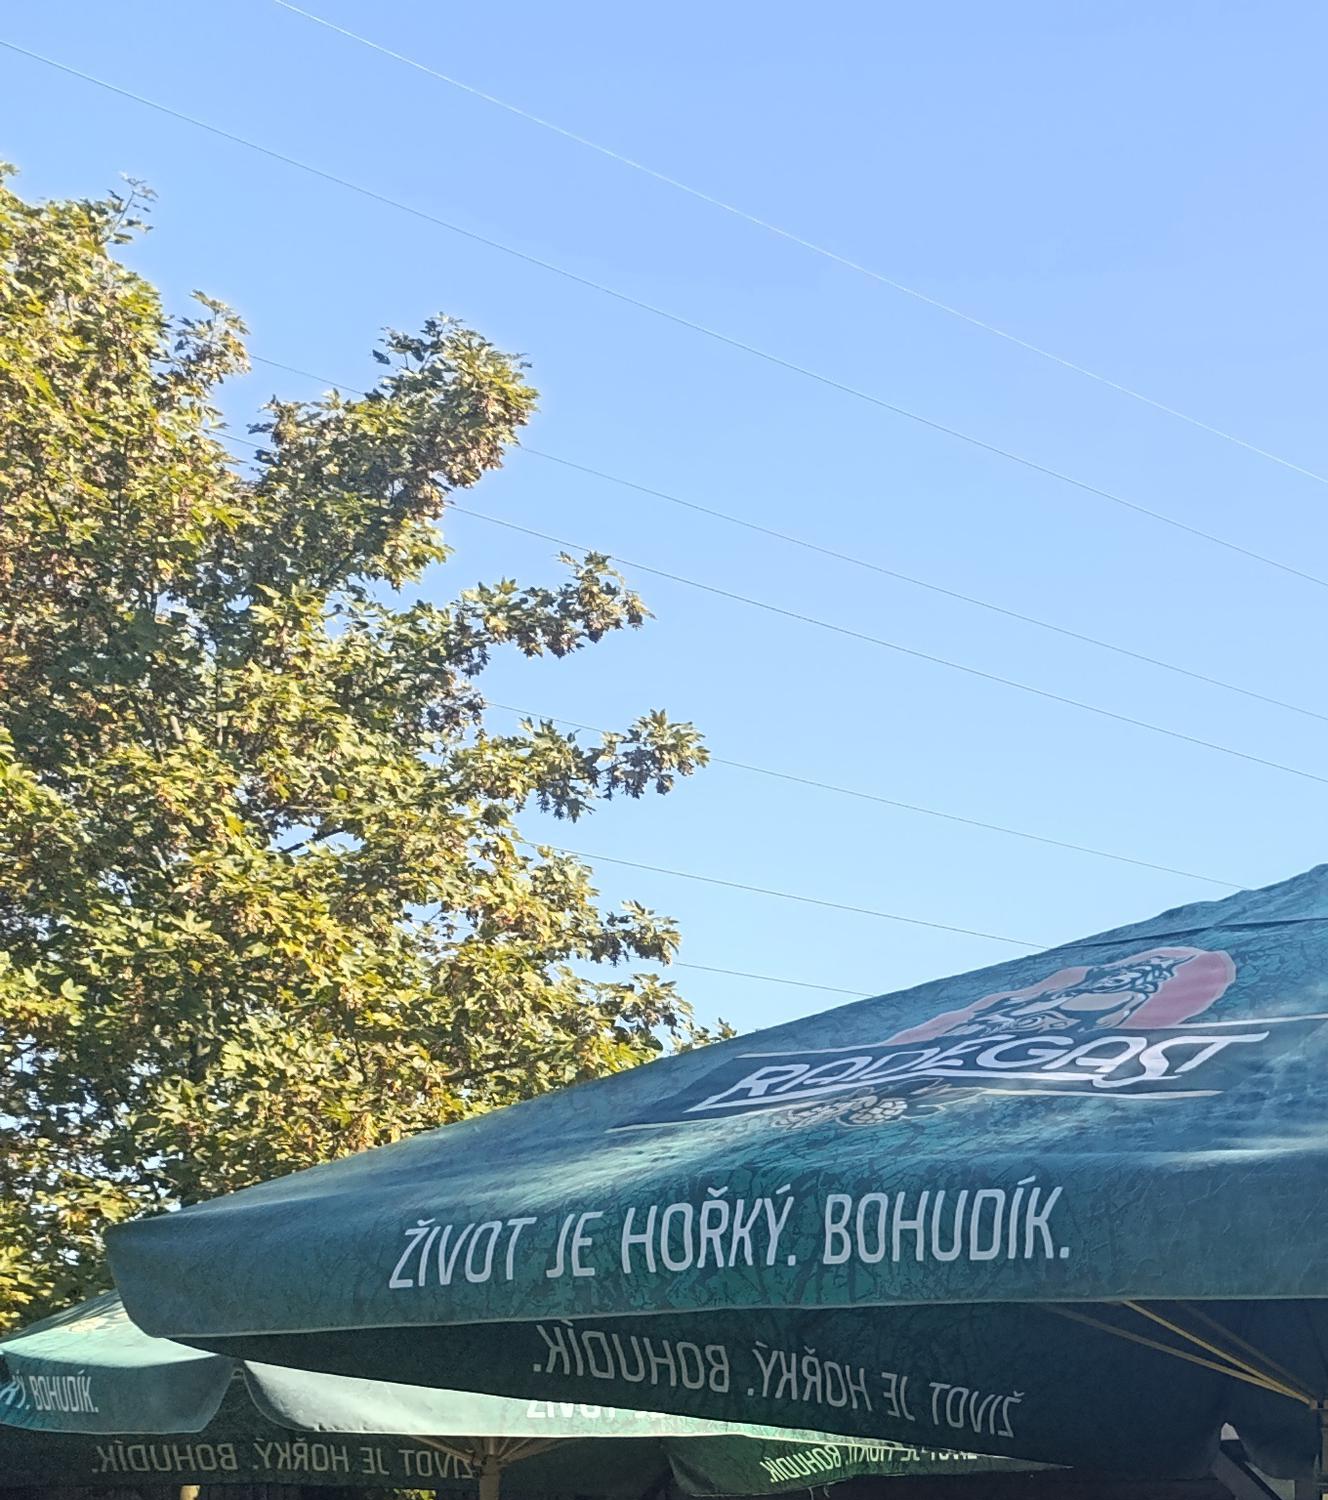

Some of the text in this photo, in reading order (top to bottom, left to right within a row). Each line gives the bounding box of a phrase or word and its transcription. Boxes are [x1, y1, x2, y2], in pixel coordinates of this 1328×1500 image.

[684, 1031, 1269, 1112] RADEGAST
[389, 1176, 1069, 1288] ŽIVOT JE HOŘKÝ. BOHUDÍK.
[29, 1369, 99, 1412] BOHUDÍK.
